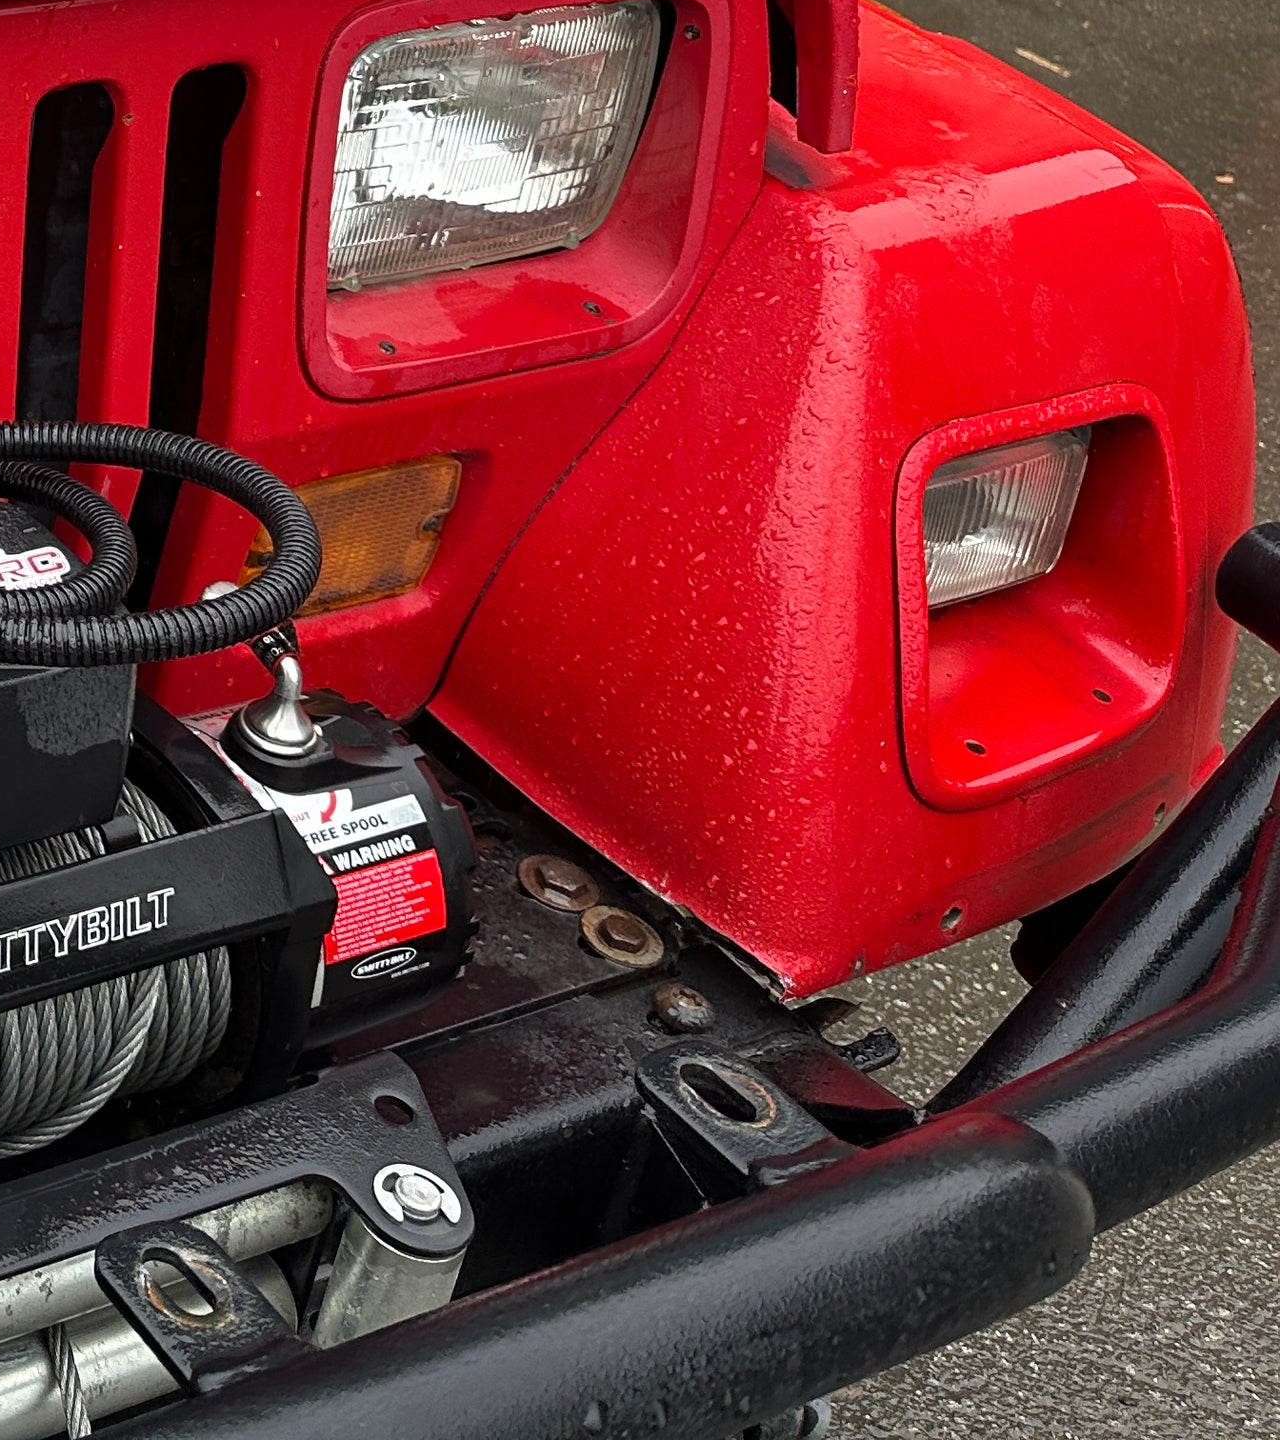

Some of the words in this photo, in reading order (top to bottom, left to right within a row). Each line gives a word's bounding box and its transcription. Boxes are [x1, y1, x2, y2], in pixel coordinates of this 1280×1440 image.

[291, 811, 311, 823] OUT
[303, 827, 339, 845] FREE
[341, 813, 389, 836] SPOOL
[332, 834, 417, 872] WARNING
